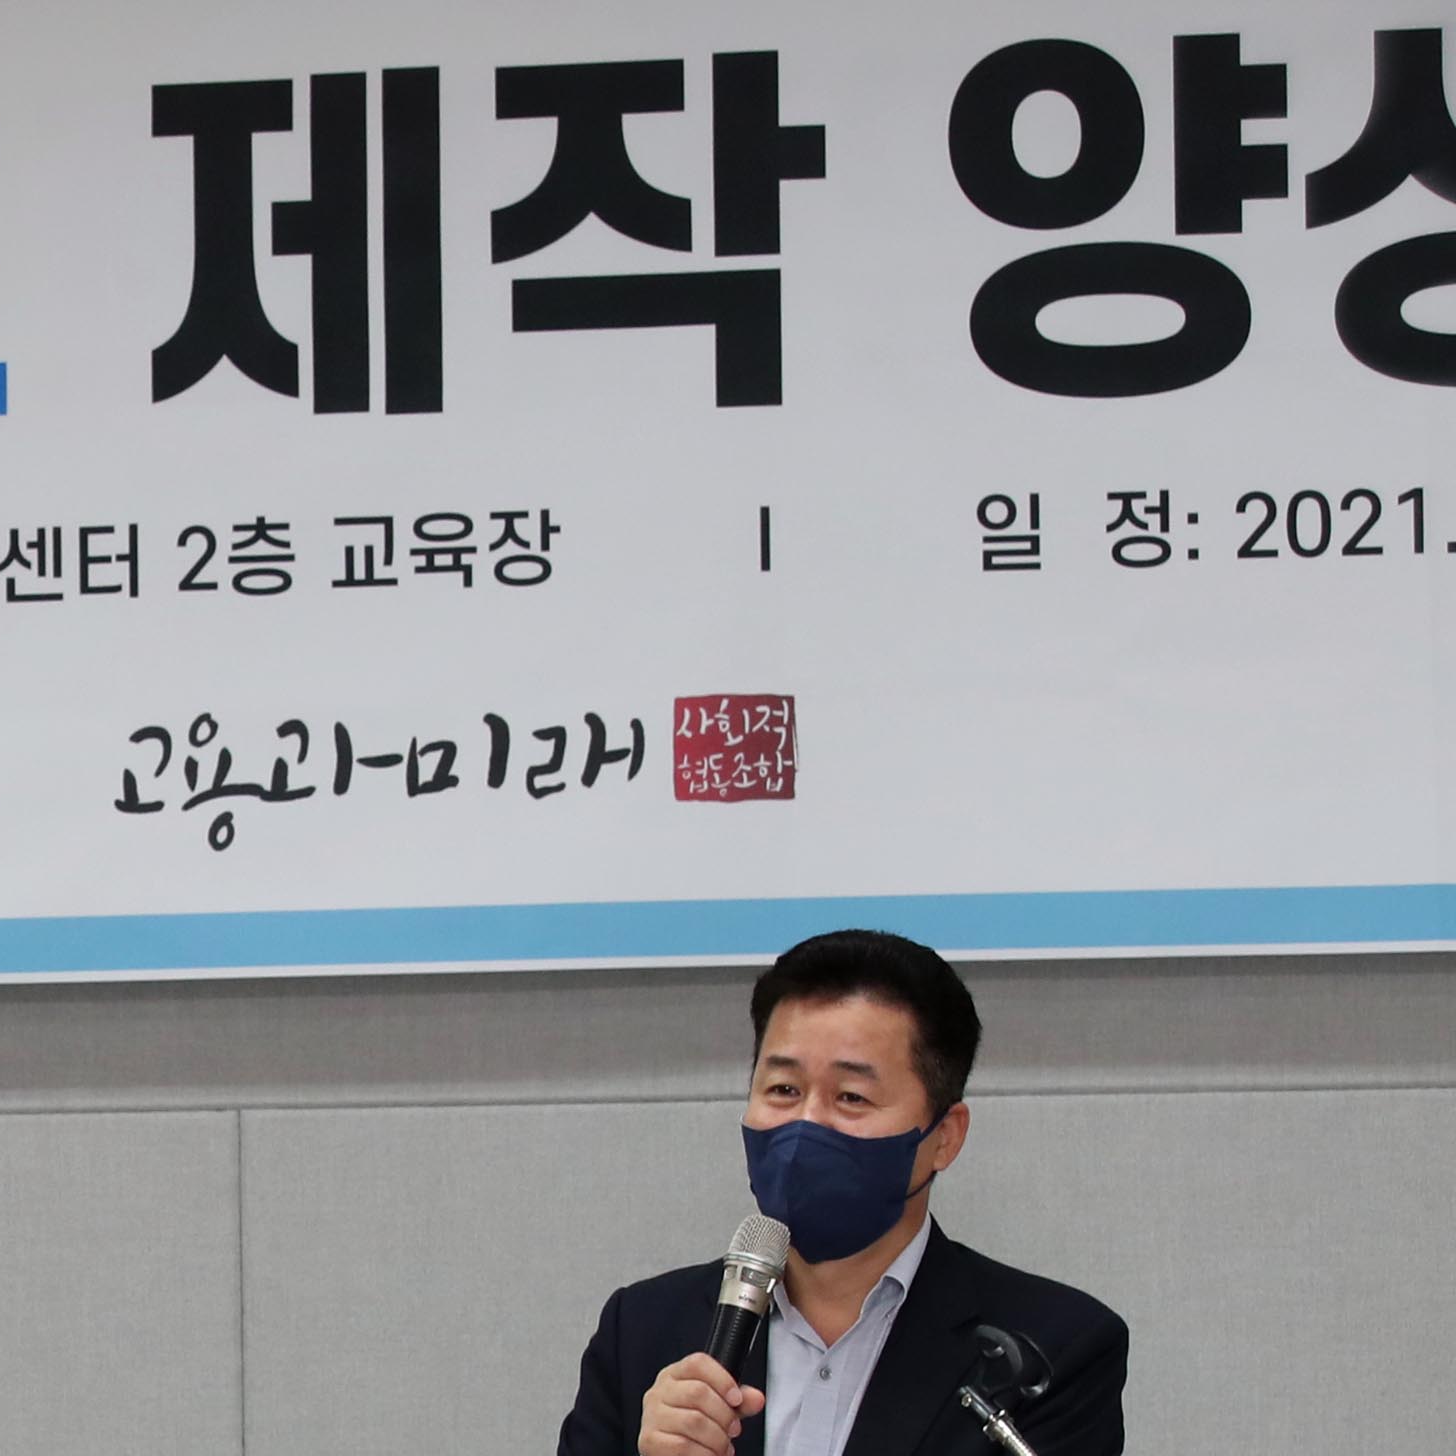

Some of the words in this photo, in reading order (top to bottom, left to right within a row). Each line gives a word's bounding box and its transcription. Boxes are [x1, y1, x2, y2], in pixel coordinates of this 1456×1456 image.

[151, 50, 826, 415] 제작
[177, 516, 295, 596] 2층
[332, 509, 561, 588] 교육장
[676, 698, 789, 749] 사회적
[677, 751, 794, 797] 협동조합
